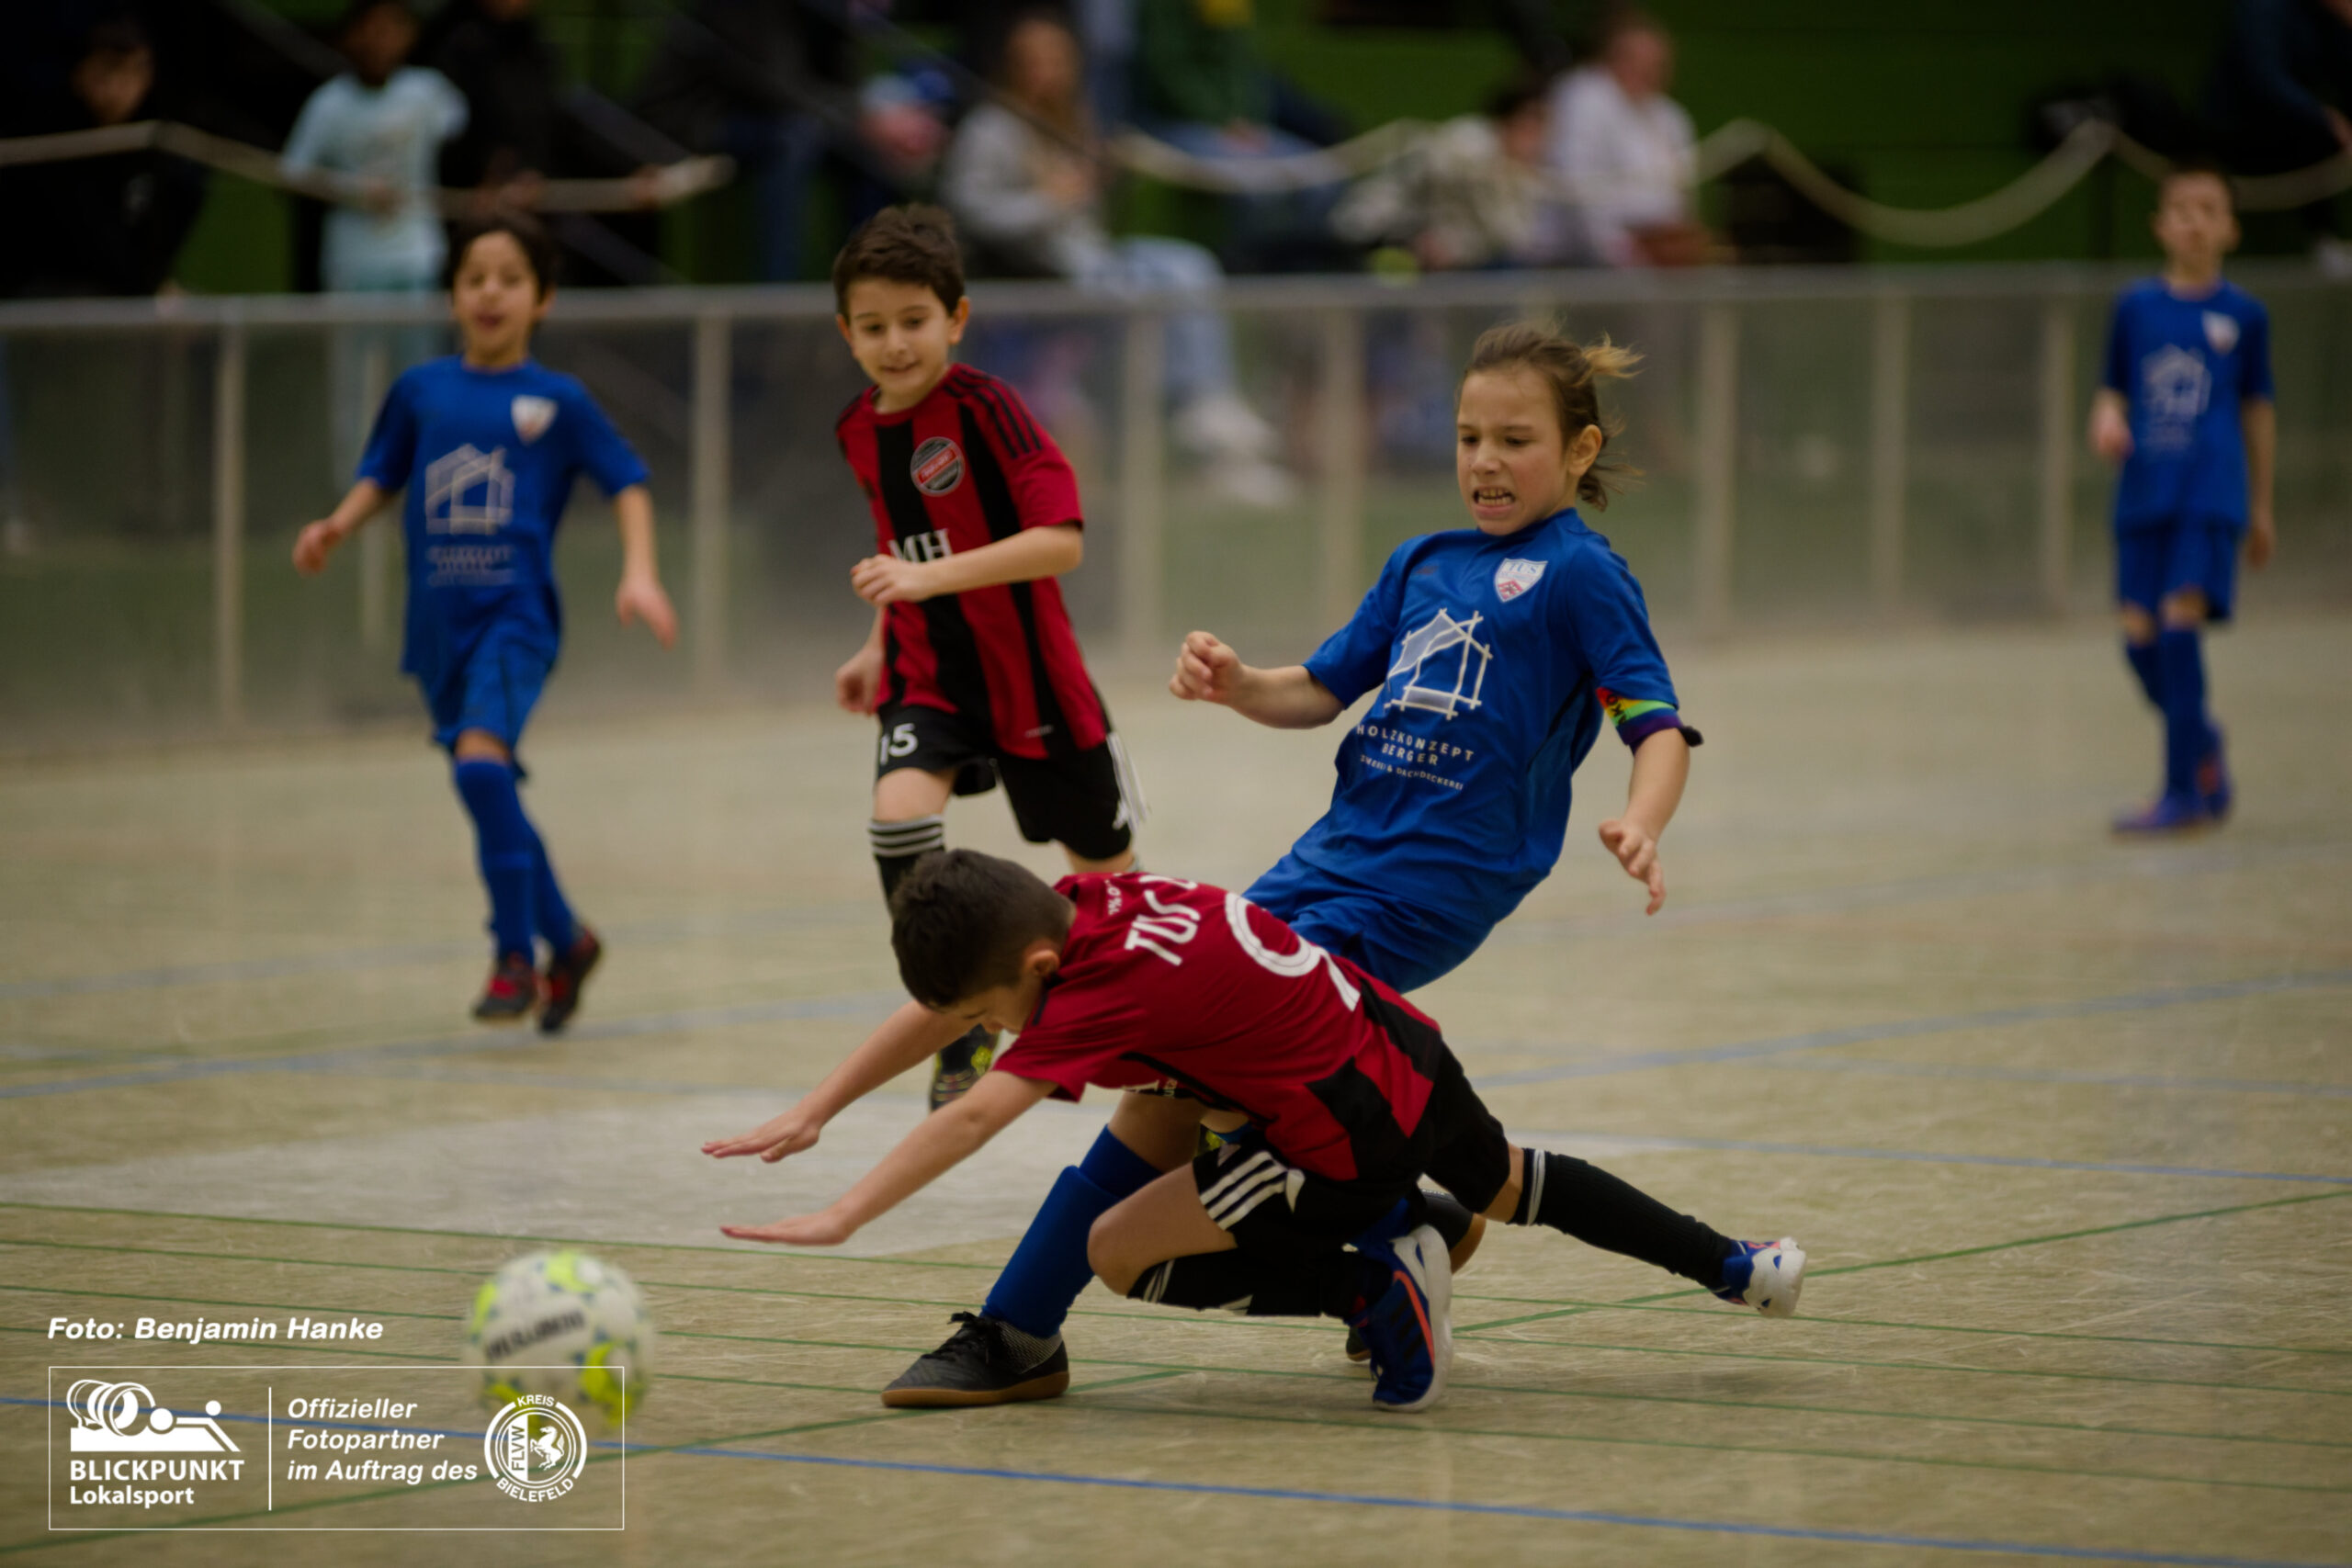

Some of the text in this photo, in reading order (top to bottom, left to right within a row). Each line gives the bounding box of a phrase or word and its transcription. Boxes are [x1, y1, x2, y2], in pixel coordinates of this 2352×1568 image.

[879, 723, 919, 766] 15
[1356, 724, 1475, 762] HOLZKONZEPT
[1382, 742, 1439, 766] BERGER
